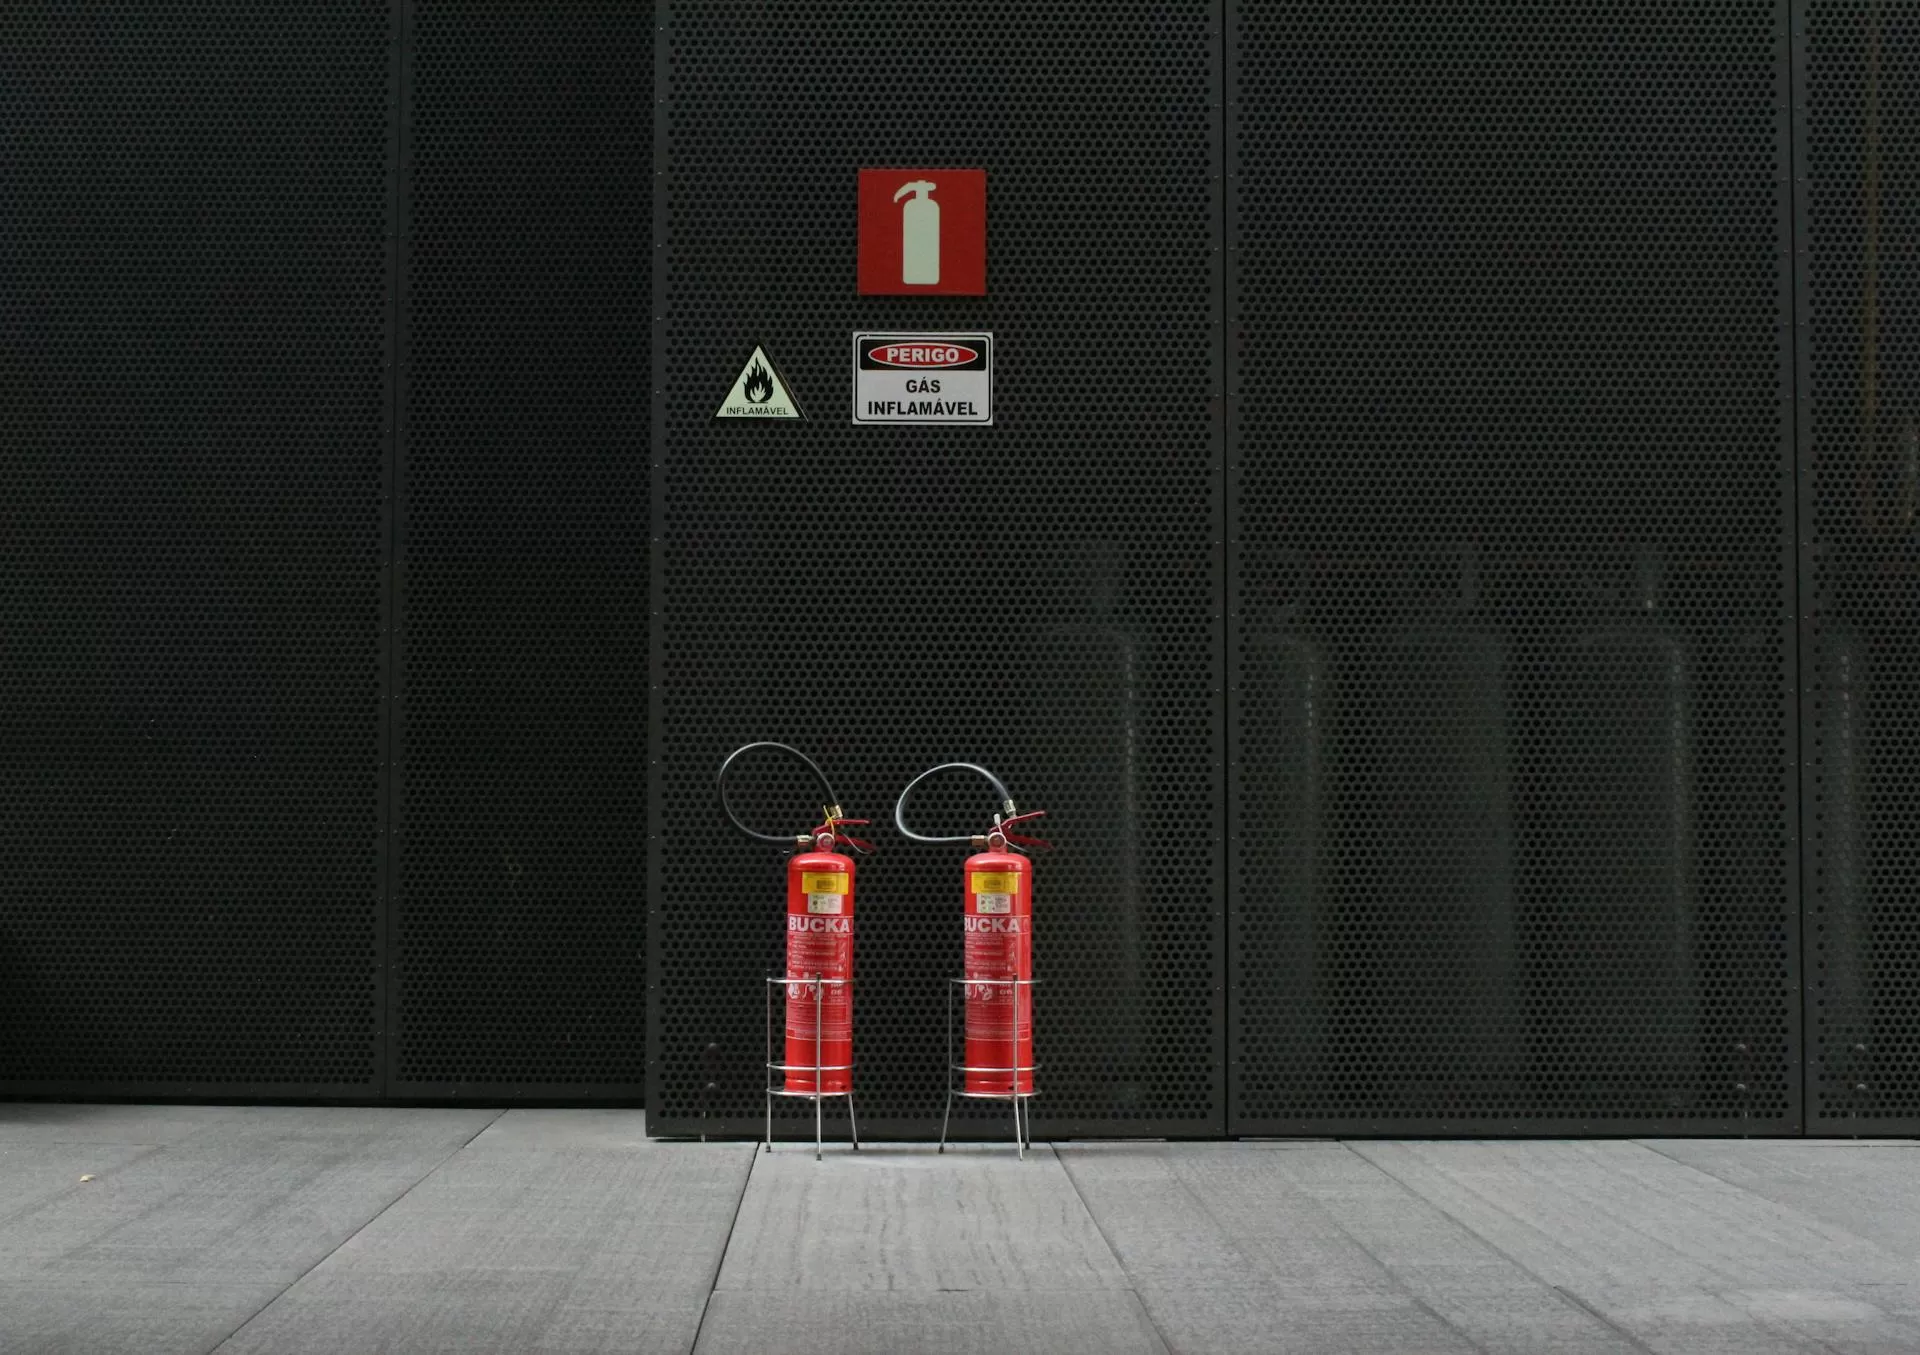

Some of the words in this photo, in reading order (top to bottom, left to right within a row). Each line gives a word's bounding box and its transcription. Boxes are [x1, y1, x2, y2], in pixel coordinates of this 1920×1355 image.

[886, 348, 960, 363] PERIGO
[906, 377, 941, 393] GÁS
[726, 405, 789, 415] INFLAMÁVEL
[868, 399, 978, 416] INFLAMÁVEL
[789, 916, 850, 933] BUCKA
